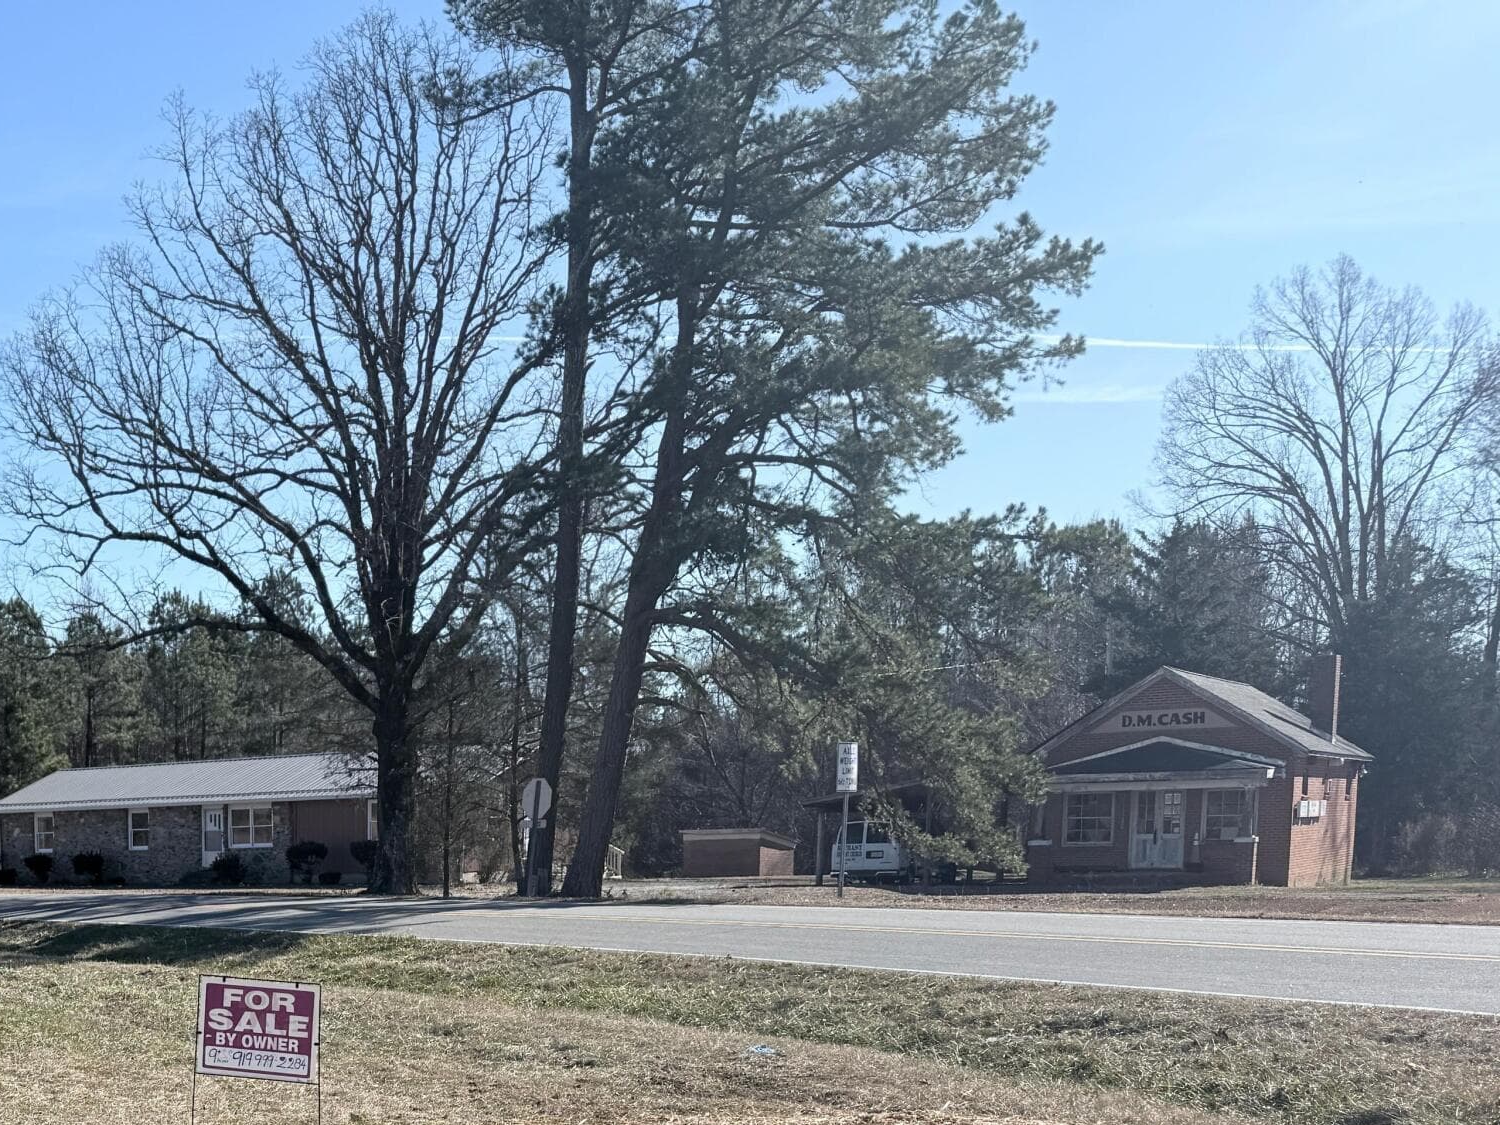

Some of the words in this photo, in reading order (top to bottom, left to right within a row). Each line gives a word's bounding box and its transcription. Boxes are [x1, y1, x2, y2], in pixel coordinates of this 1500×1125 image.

[222, 988, 296, 1013] FOR
[207, 1008, 309, 1038] SALE
[215, 1032, 236, 1046] BY
[241, 1034, 299, 1052] OWNER
